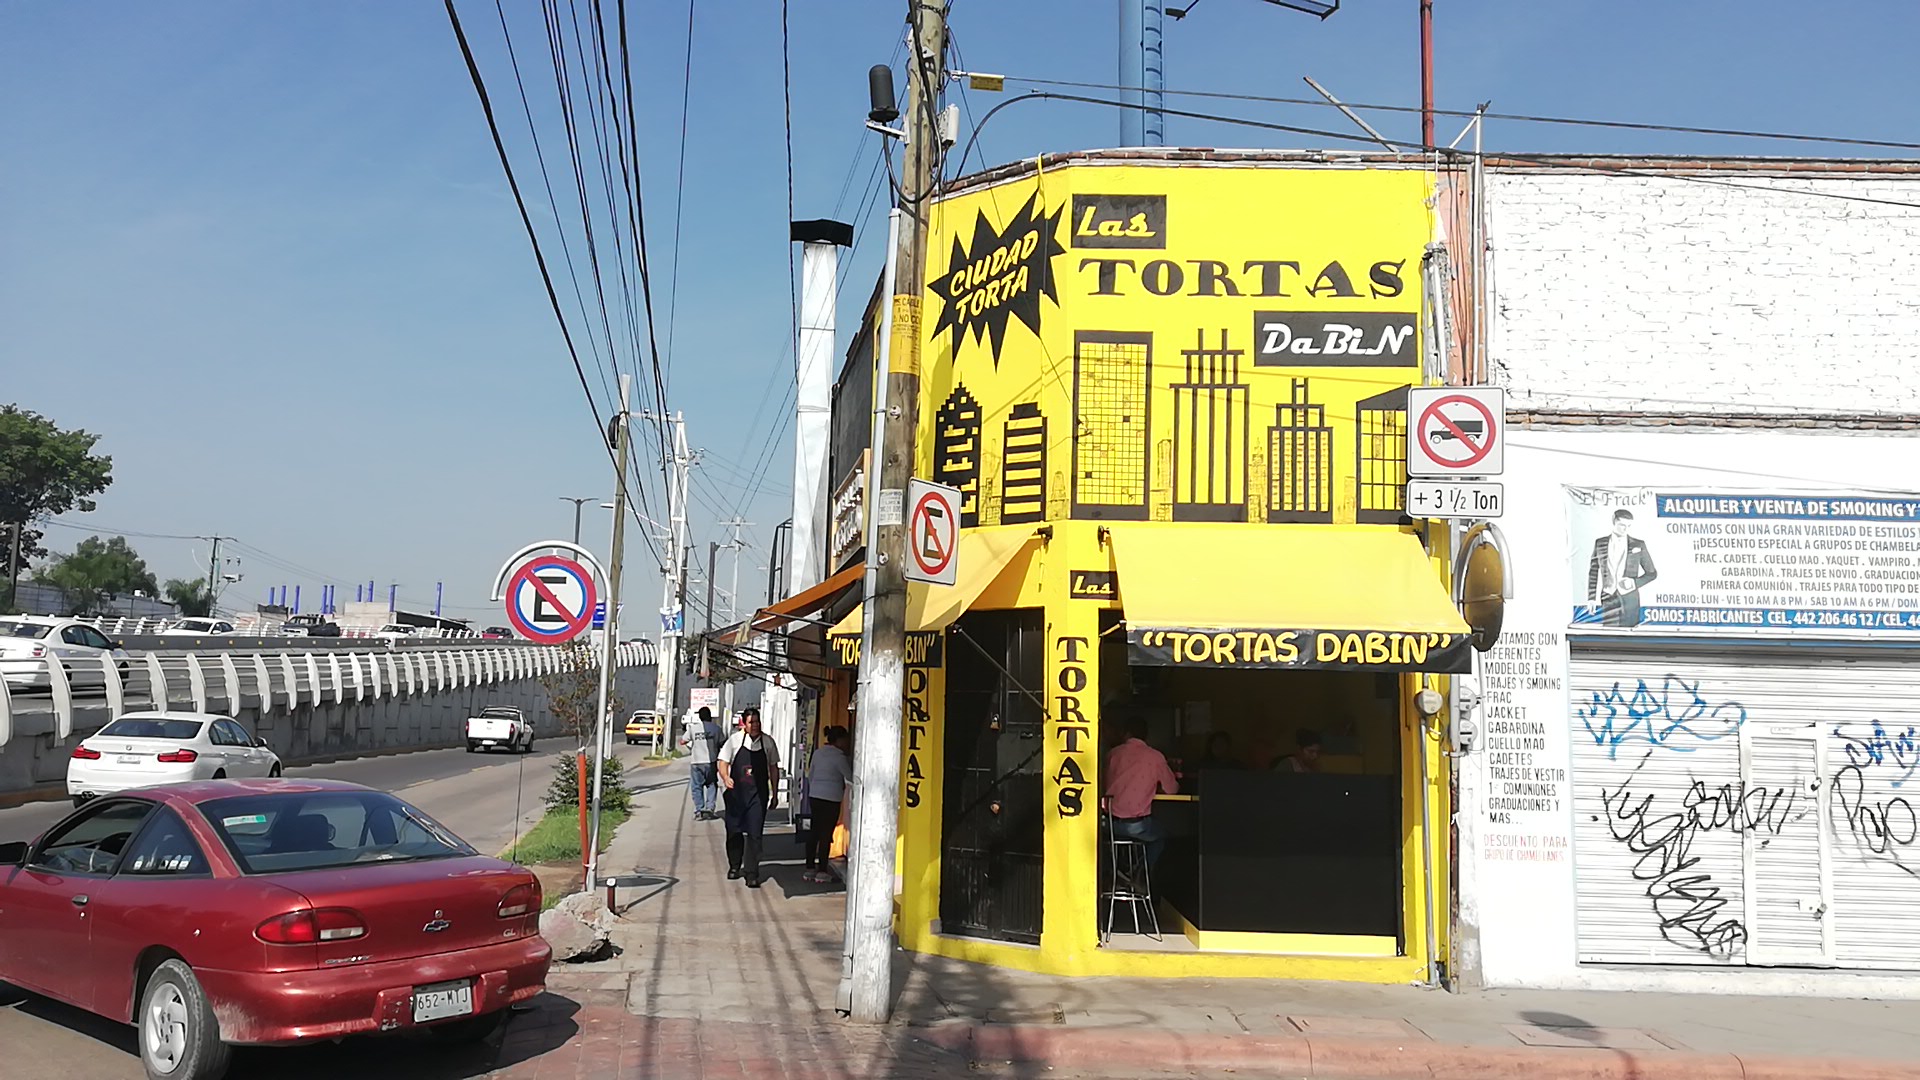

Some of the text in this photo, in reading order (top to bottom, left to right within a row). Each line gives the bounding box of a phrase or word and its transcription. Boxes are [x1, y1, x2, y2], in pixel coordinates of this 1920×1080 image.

[1076, 206, 1155, 238] Las
[949, 229, 1039, 297] CIUDAD
[1078, 258, 1407, 300] TORTAS
[955, 267, 1028, 324] TORTA
[1434, 490, 1442, 509] 3
[1473, 490, 1498, 510] Ton
[1664, 499, 1916, 517] ALQUILER Y VENTA DE SMOKING Y
[1666, 523, 1916, 538] CONTAMOS CON UNA GRAN VARIEDAD DE ESTILOS
[1758, 539, 1801, 550] ESPECIAL
[1804, 540, 1811, 550] A
[1813, 540, 1852, 550] GRUPOS
[1855, 541, 1867, 551] DE
[1694, 553, 1910, 567] FRAC CADETE CUELLO MAO YAQUET VAMPIRO
[1721, 567, 1774, 577] GABARDINA
[1781, 568, 1813, 578] TRAJES
[1815, 569, 1826, 578] DE
[1829, 569, 1857, 579] NOVIO
[1072, 575, 1113, 595] Las
[1700, 580, 1919, 593] PRIMERA COMUNIÓN TRAJES PARA TODO TIPO DE
[1656, 594, 1699, 604] HORARIO:
[1701, 594, 1719, 604] LUN
[1726, 595, 1741, 604] VIE
[1744, 596, 1754, 605] 10
[1756, 596, 1771, 605] AM
[1788, 597, 1803, 606] PM
[1810, 597, 1828, 606] SAB
[1831, 597, 1841, 606] 10
[1843, 598, 1858, 607] AM
[1876, 598, 1890, 607] PM
[1897, 598, 1919, 608] DOM
[1643, 609, 1684, 622] SOMOS
[1686, 610, 1763, 623] FABRICANTES
[1767, 612, 1792, 624] CEL.
[1793, 612, 1816, 625] 442
[1818, 613, 1840, 625] 206
[1841, 613, 1857, 626] 46
[1860, 613, 1874, 626] 12
[1882, 614, 1907, 627] CEL.
[1538, 633, 1558, 646] CON
[1142, 631, 1451, 665] “TORTAS DABIN”
[1485, 662, 1548, 675] MODELOS EN
[1486, 676, 1516, 689] TRAJES
[1526, 677, 1561, 690] SMOKING
[1486, 691, 1512, 703] FRAC
[1487, 706, 1526, 719] JACKET
[1052, 637, 1092, 820] TORTAS
[1488, 721, 1545, 735] GABARDINA
[906, 669, 931, 808] ORTAS
[1489, 737, 1545, 750] CUELLO MAO
[1489, 752, 1533, 766] CADETES
[1489, 766, 1565, 782] TRAJES DE VESTIR
[1503, 782, 1557, 797] COMUNIONES
[1488, 797, 1551, 811] GRADUACIONES
[1484, 834, 1568, 848] DESCUENTO PARA
